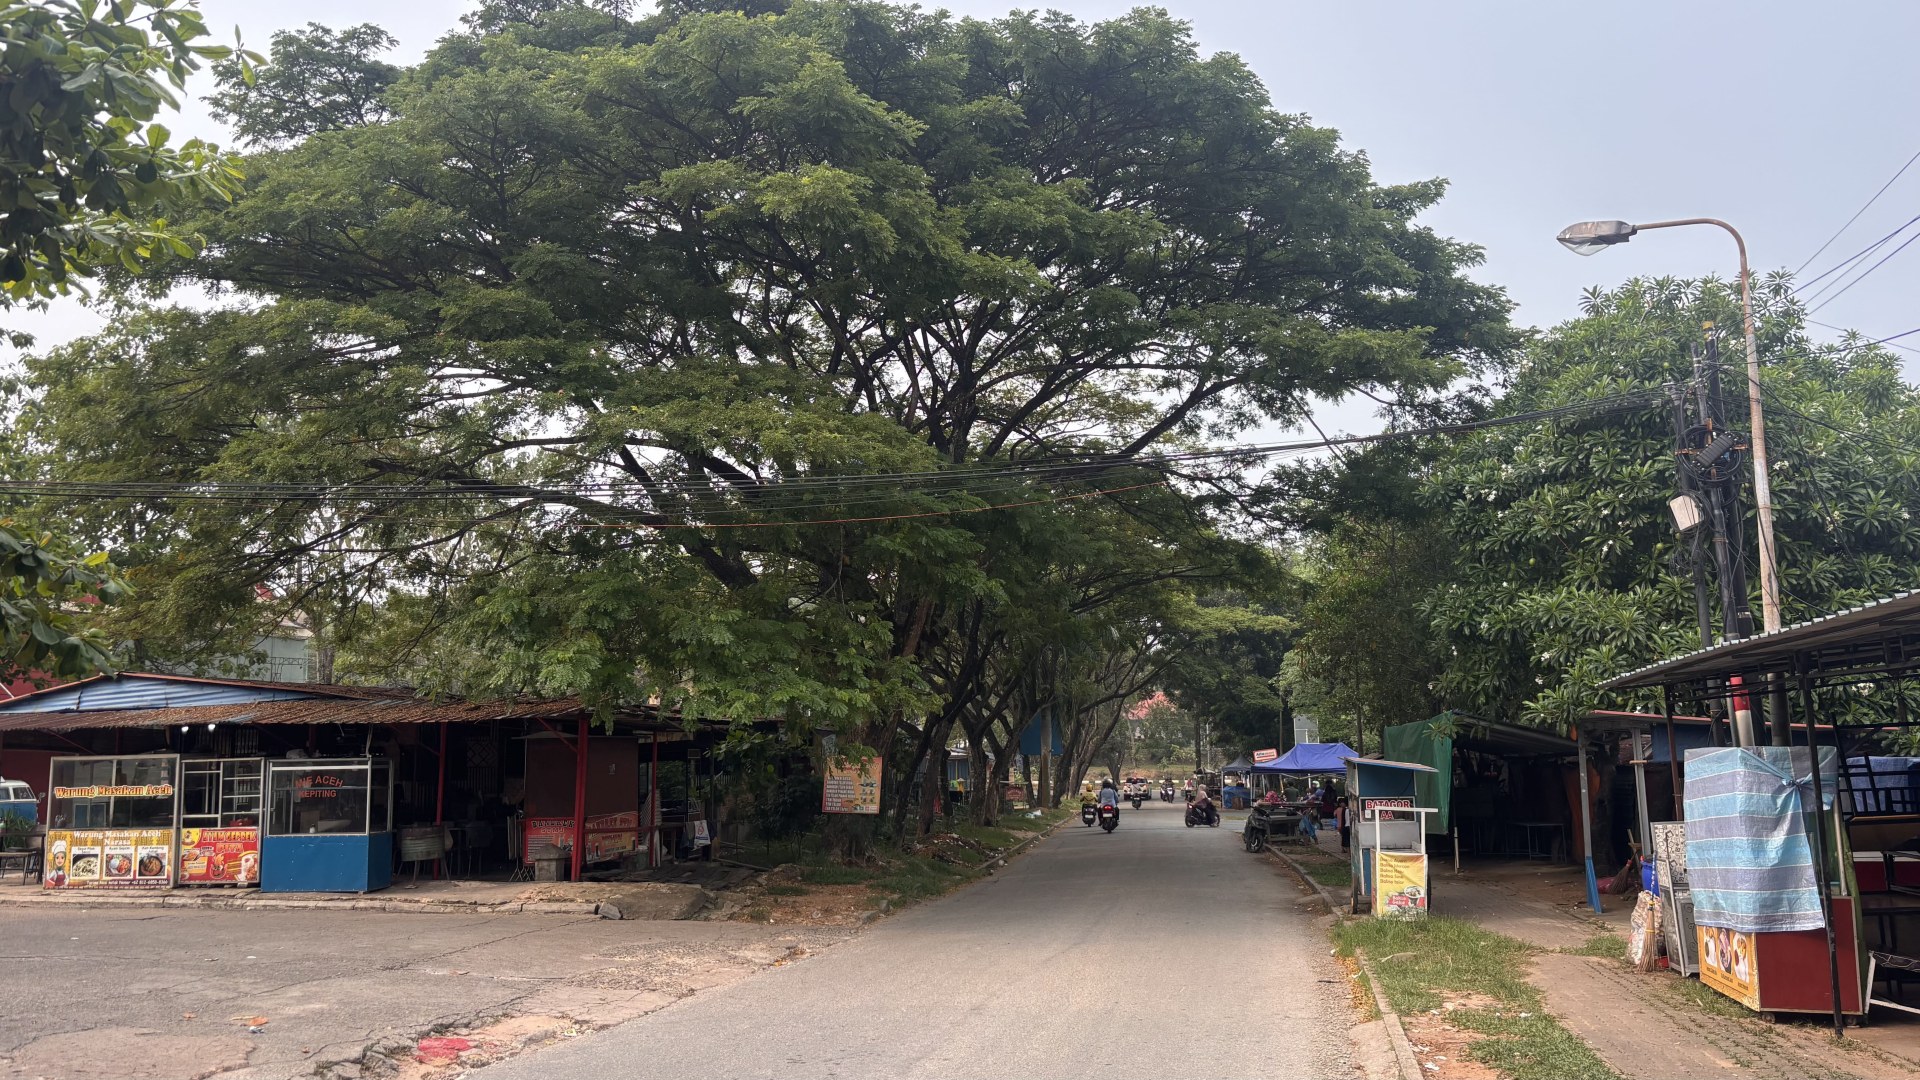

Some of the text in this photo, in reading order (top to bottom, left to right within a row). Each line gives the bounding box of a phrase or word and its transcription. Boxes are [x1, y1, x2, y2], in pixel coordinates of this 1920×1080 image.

[315, 775, 343, 787] ACEH
[54, 784, 173, 798] Warung Masakan Aceh
[299, 790, 337, 798] KEPITING
[1366, 800, 1410, 810] BATAGOR
[74, 831, 103, 839] Warung
